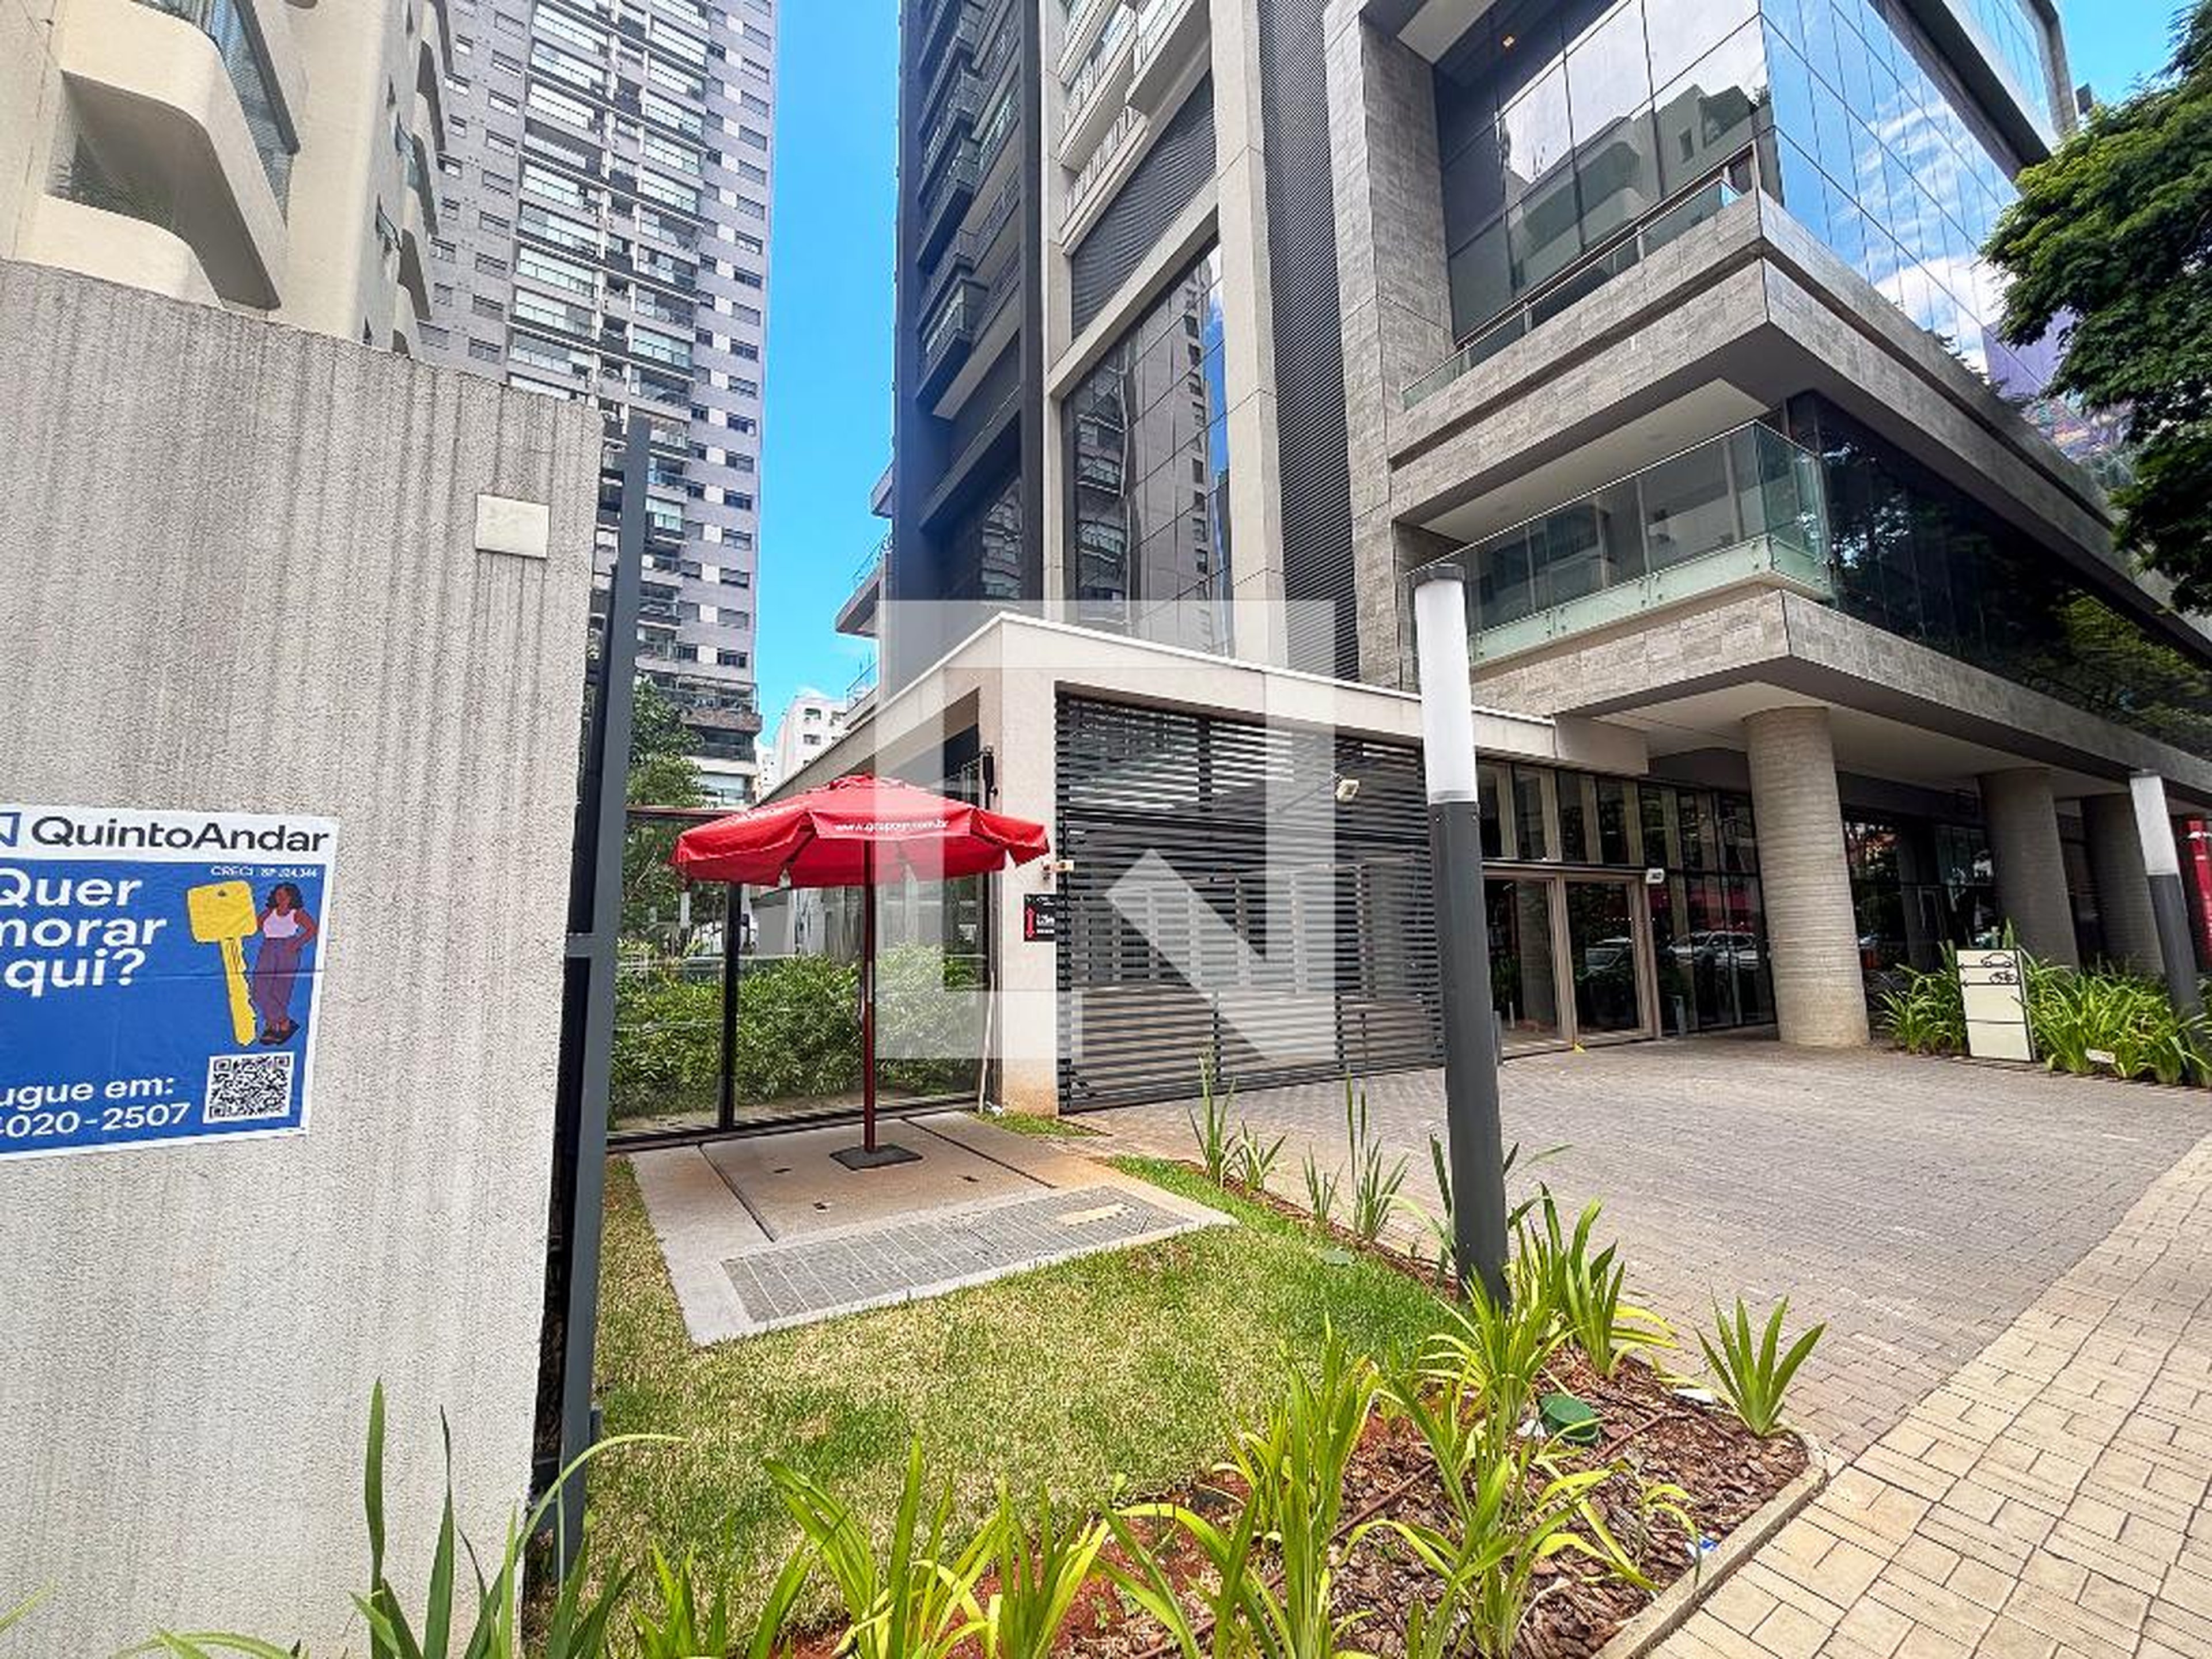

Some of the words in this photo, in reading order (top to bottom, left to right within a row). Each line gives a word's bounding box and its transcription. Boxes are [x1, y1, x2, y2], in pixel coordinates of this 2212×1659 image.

[32, 816, 329, 851] QuintoAndar
[0, 868, 143, 907] Quer
[105, 1077, 174, 1099] em:
[0, 1102, 191, 1138] 020-2507
